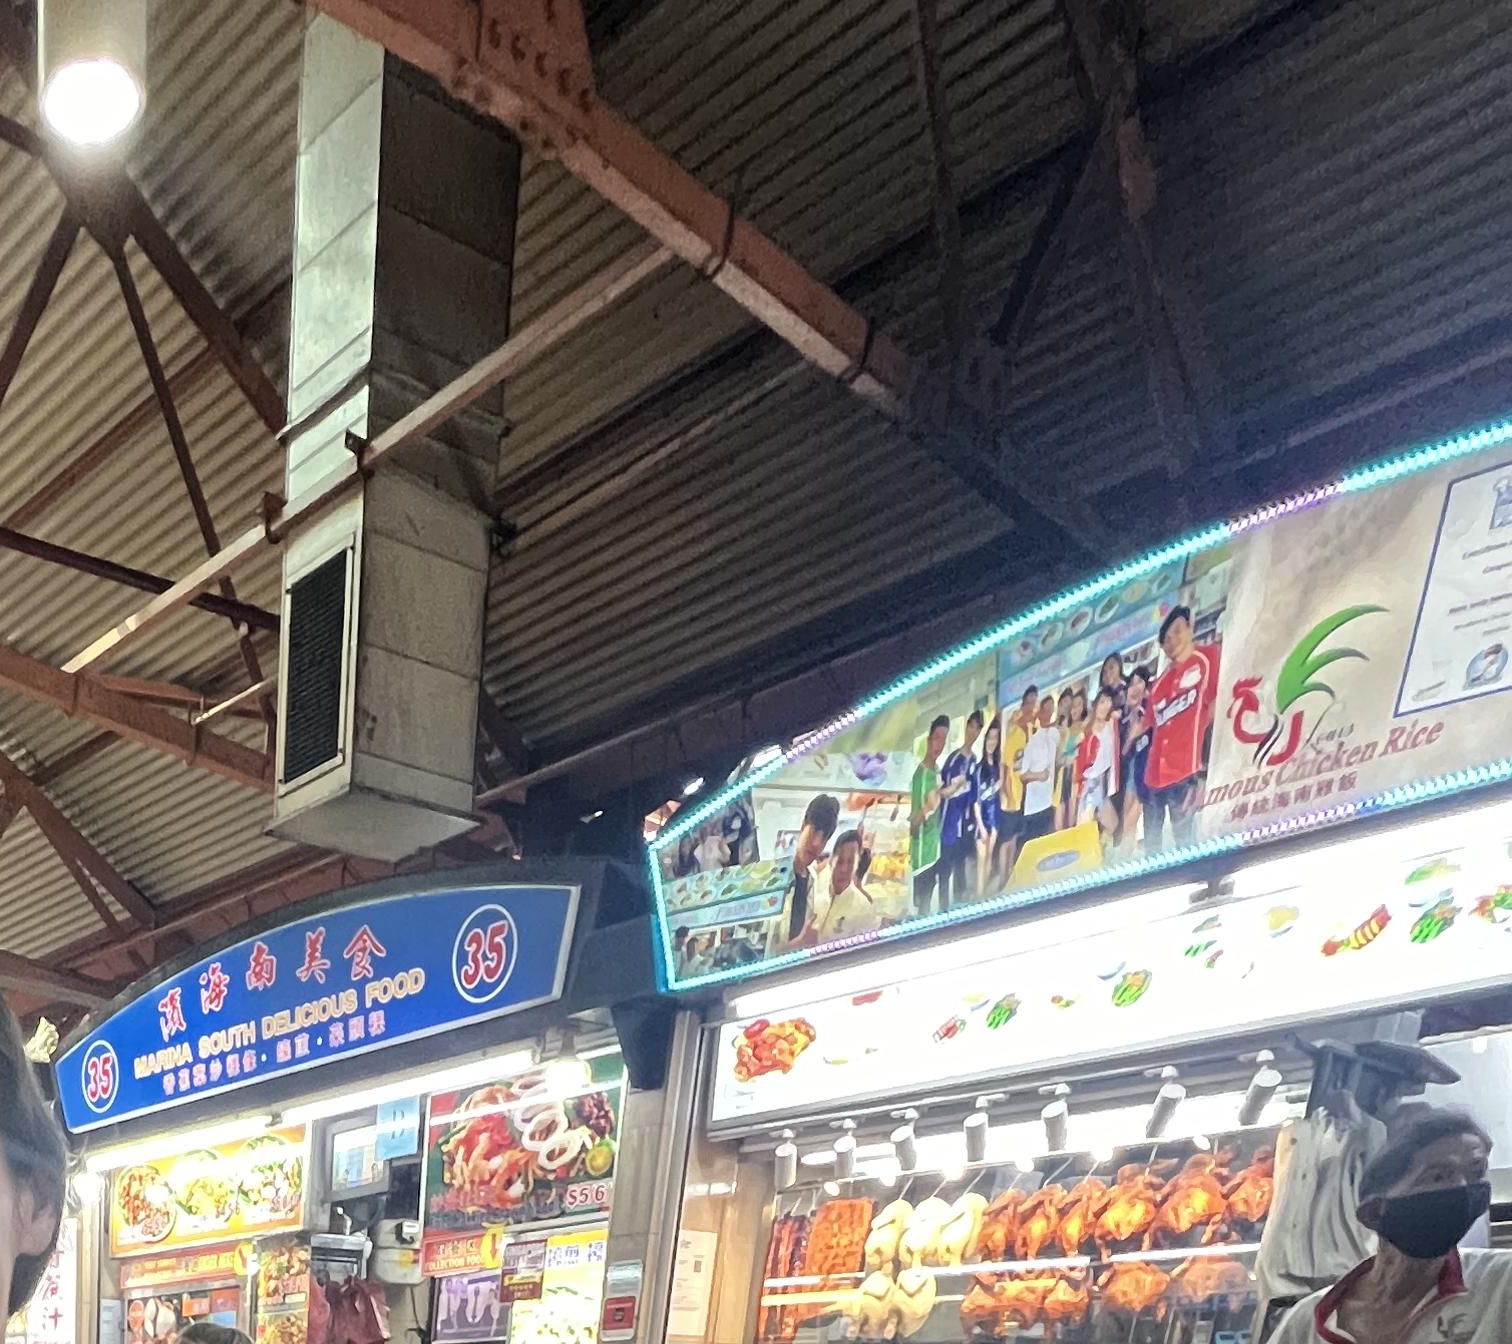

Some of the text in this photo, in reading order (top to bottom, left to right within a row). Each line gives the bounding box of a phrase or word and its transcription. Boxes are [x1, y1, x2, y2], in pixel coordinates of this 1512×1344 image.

[1275, 740, 1379, 787] Chicken
[1379, 718, 1445, 757] Rice
[461, 920, 509, 990] 35
[134, 1040, 194, 1080] MARINA
[198, 1020, 256, 1060] SOUTH
[262, 989, 357, 1040] DELICIOUS
[366, 967, 426, 1007] FOOD
[87, 1054, 114, 1101] 35
